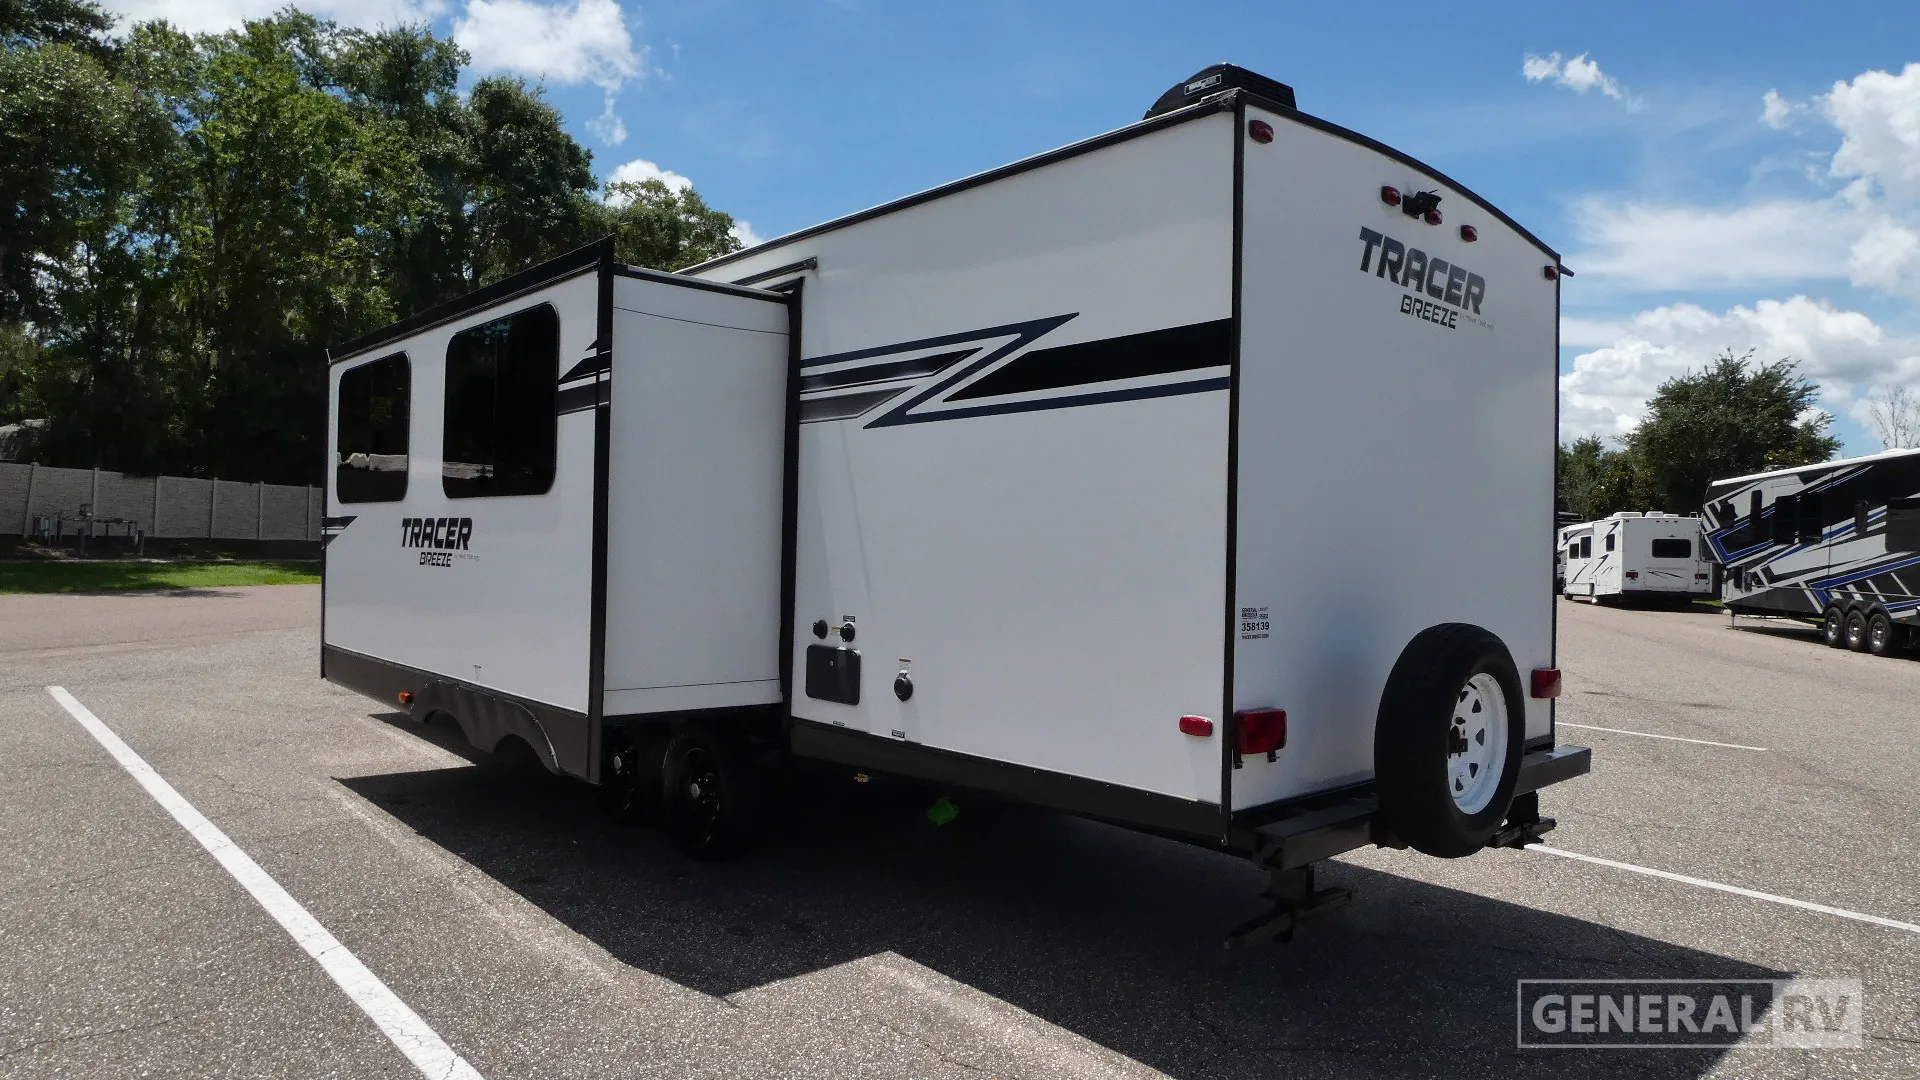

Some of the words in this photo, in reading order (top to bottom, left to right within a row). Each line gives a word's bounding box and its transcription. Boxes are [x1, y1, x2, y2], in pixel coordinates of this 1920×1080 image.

[1359, 226, 1486, 315] TRACER
[1400, 293, 1459, 330] BREEZE
[401, 517, 473, 550] TRACER
[419, 551, 453, 567] BREEZE
[1241, 621, 1270, 631] 358139
